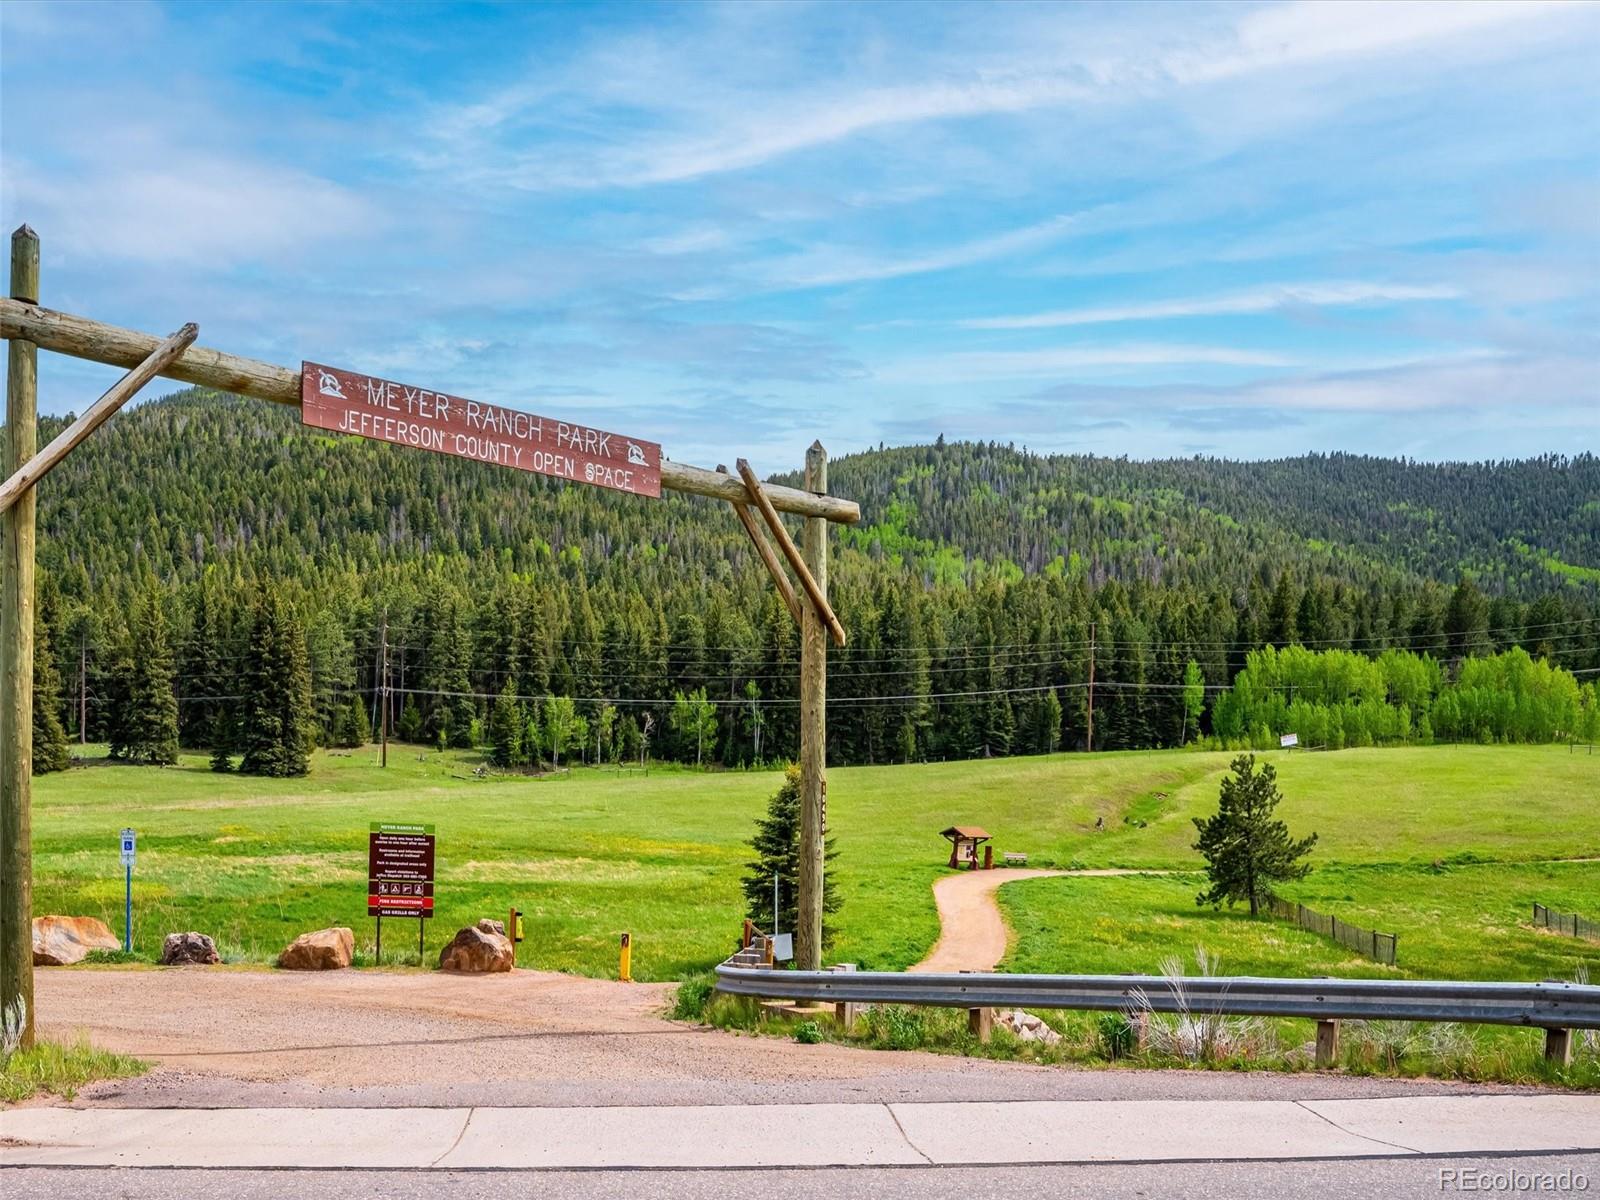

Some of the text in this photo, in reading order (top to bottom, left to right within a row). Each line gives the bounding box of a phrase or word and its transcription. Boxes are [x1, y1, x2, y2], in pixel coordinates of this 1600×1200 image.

[338, 409, 634, 491] JEFFERSON COUNTY OPEN SPACE
[367, 378, 612, 458] MEYER RANCH PARK
